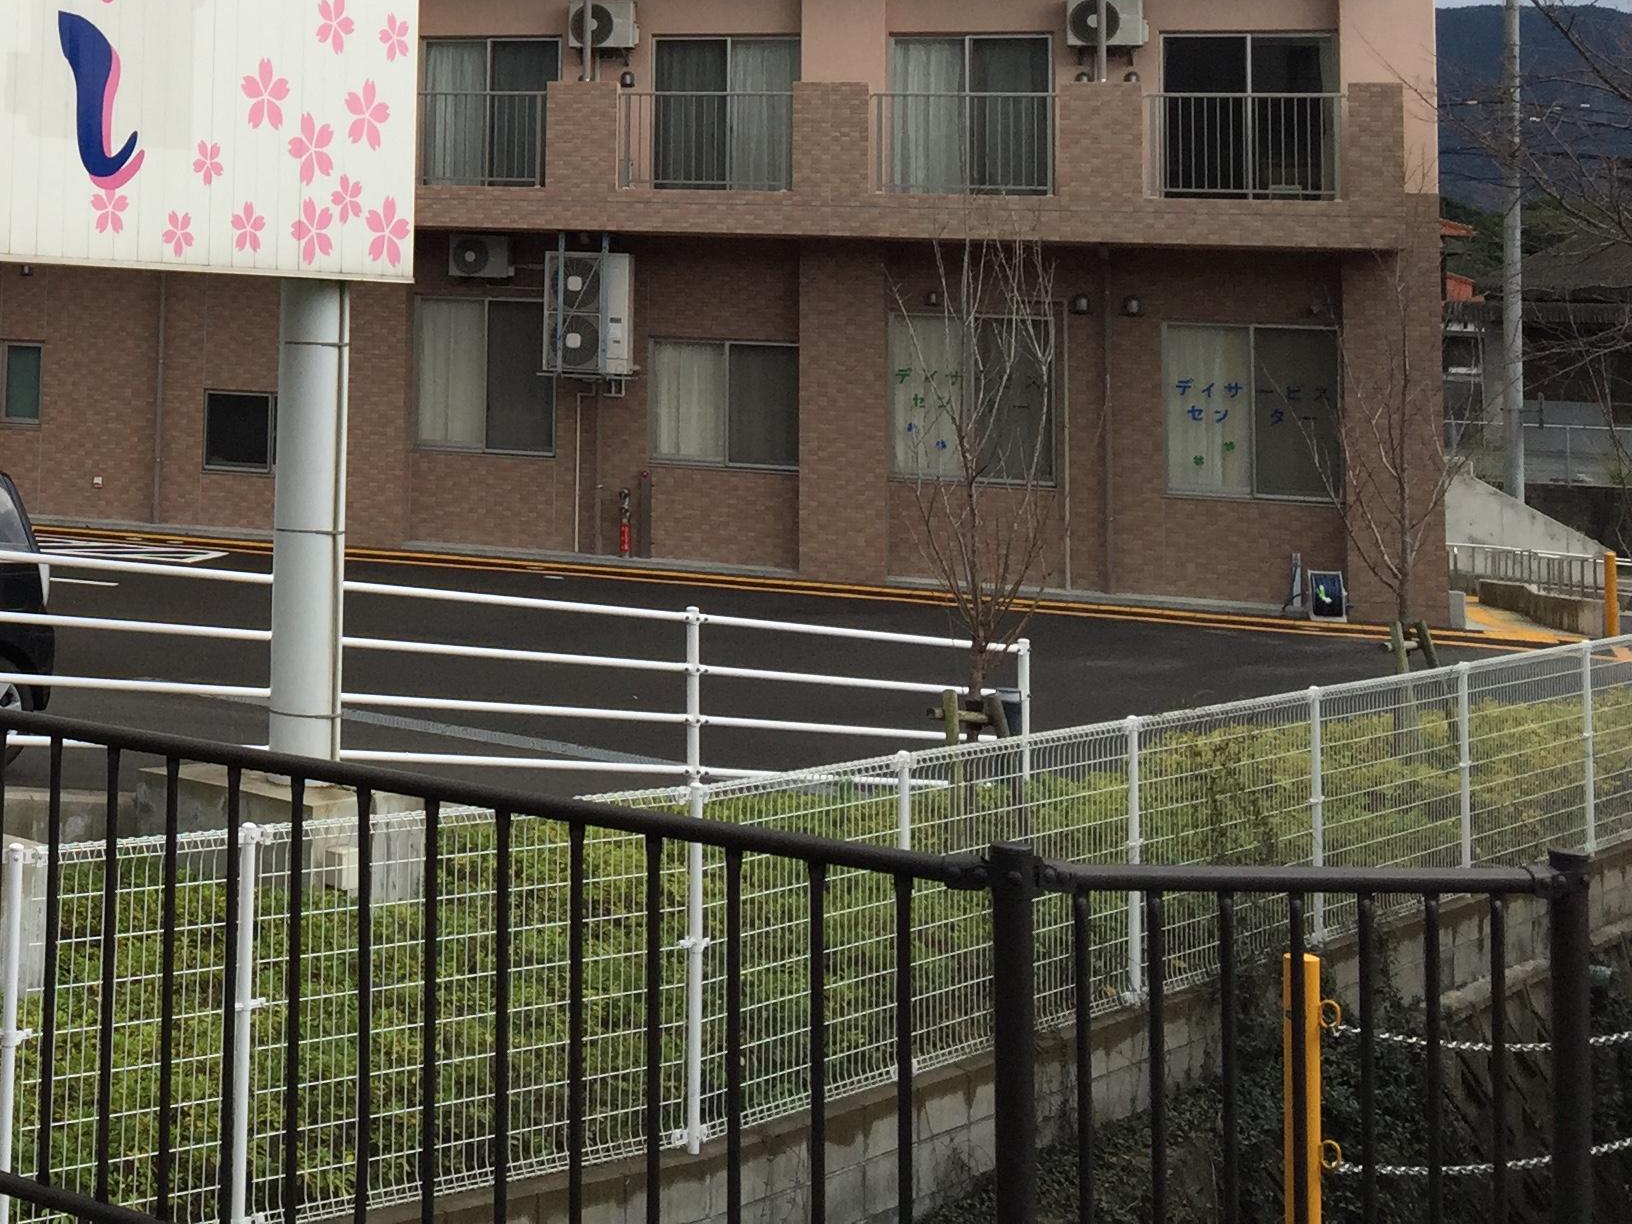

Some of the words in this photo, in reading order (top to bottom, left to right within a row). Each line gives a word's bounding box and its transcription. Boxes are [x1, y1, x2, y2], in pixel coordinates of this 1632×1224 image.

[1175, 378, 1330, 401] デイサービス
[1186, 405, 1318, 424] センター
